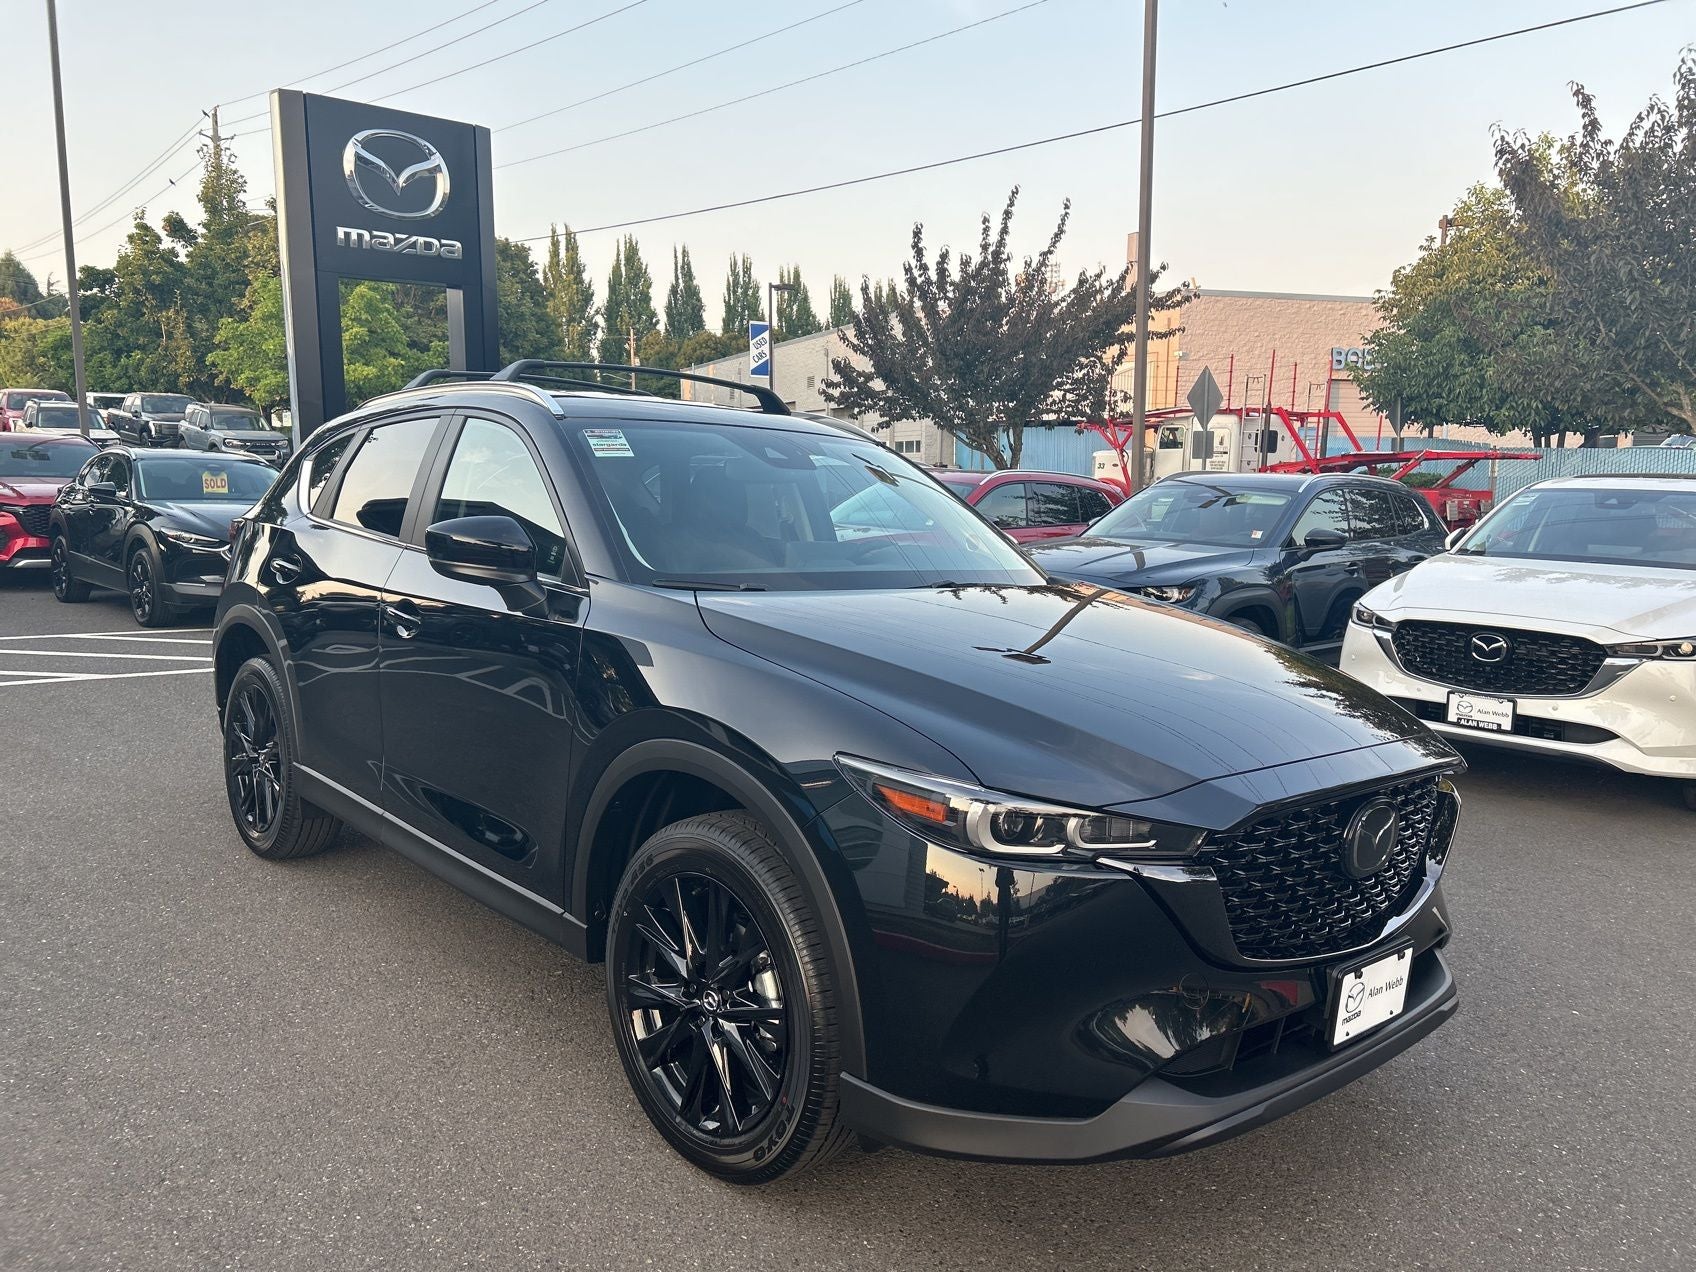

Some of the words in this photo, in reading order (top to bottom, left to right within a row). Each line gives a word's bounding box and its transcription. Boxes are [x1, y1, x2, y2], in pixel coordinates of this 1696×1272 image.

[752, 336, 768, 350] USED
[752, 350, 768, 364] CARS
[204, 478, 227, 489] SOLD
[1491, 710, 1510, 718] Webb
[1459, 718, 1478, 727] ALAN
[1478, 721, 1498, 730] WEBB
[1367, 985, 1384, 999] Alan
[1385, 976, 1404, 992] Webb
